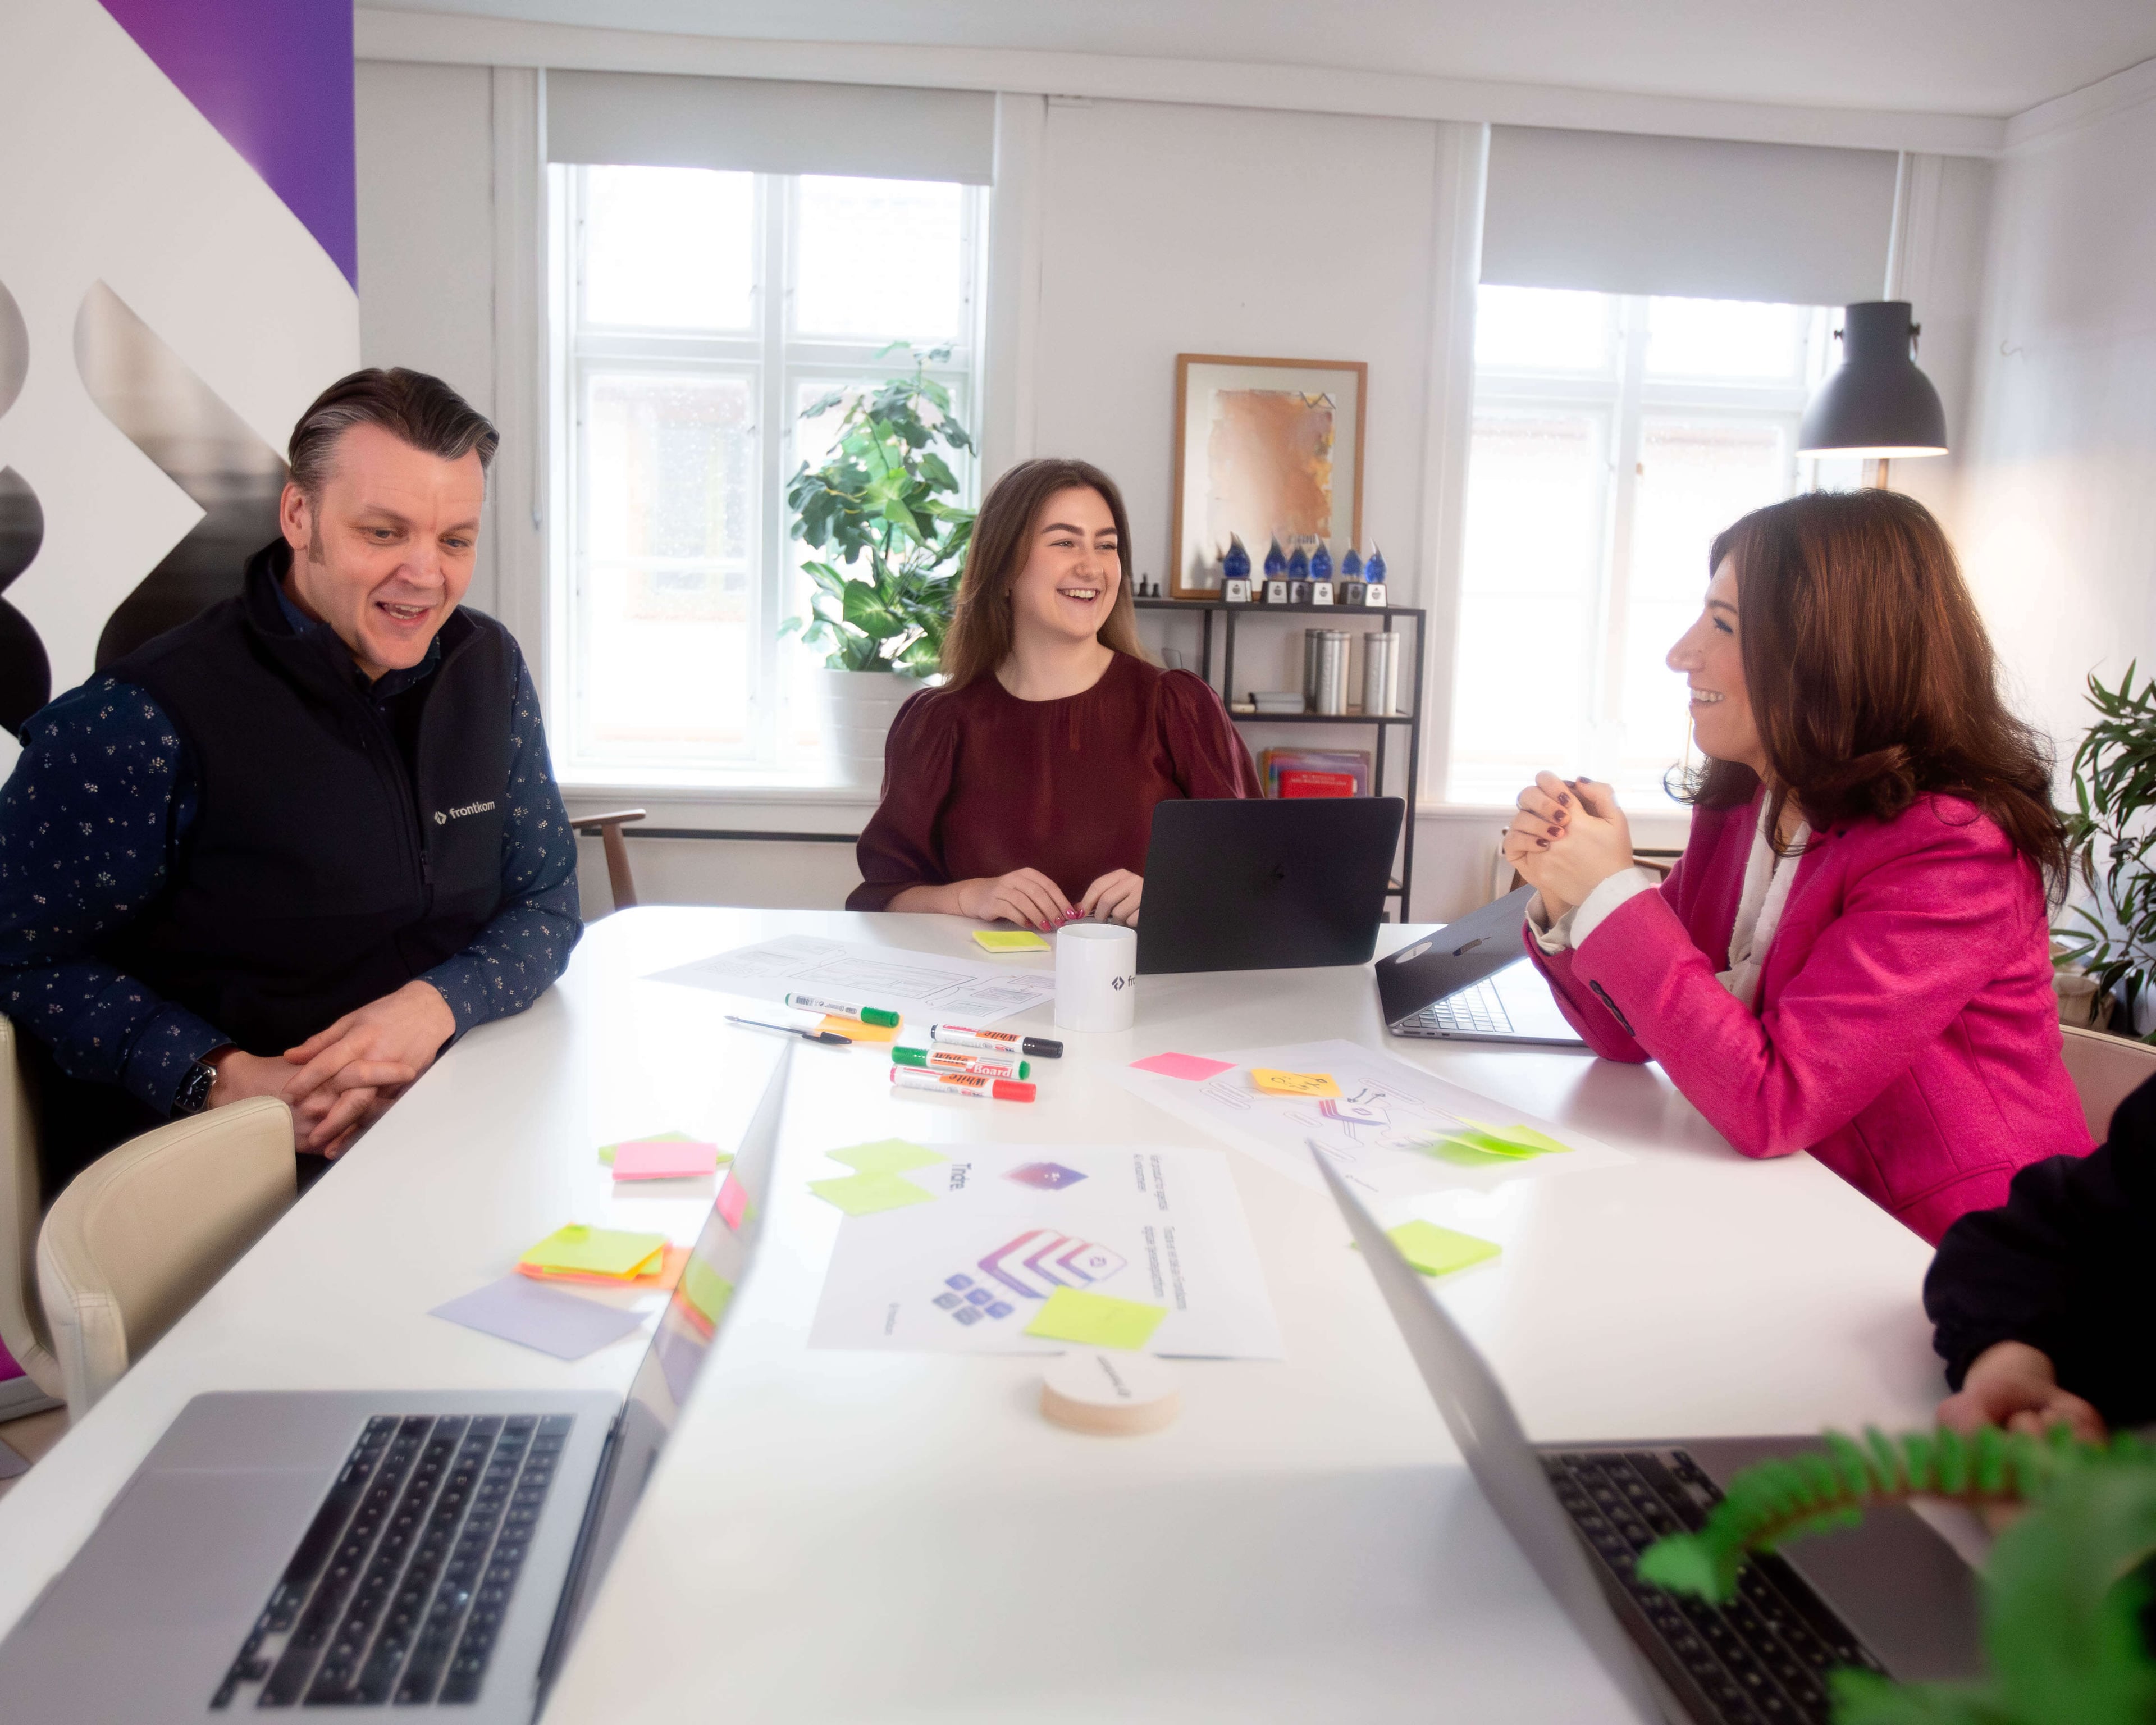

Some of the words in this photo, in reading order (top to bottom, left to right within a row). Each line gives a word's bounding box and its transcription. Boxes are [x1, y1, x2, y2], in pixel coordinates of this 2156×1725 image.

[450, 801, 495, 819] frontkom
[984, 1031, 1017, 1042] White
[933, 1052, 969, 1066] White
[973, 1064, 1013, 1078] Board
[949, 1074, 986, 1087] White
